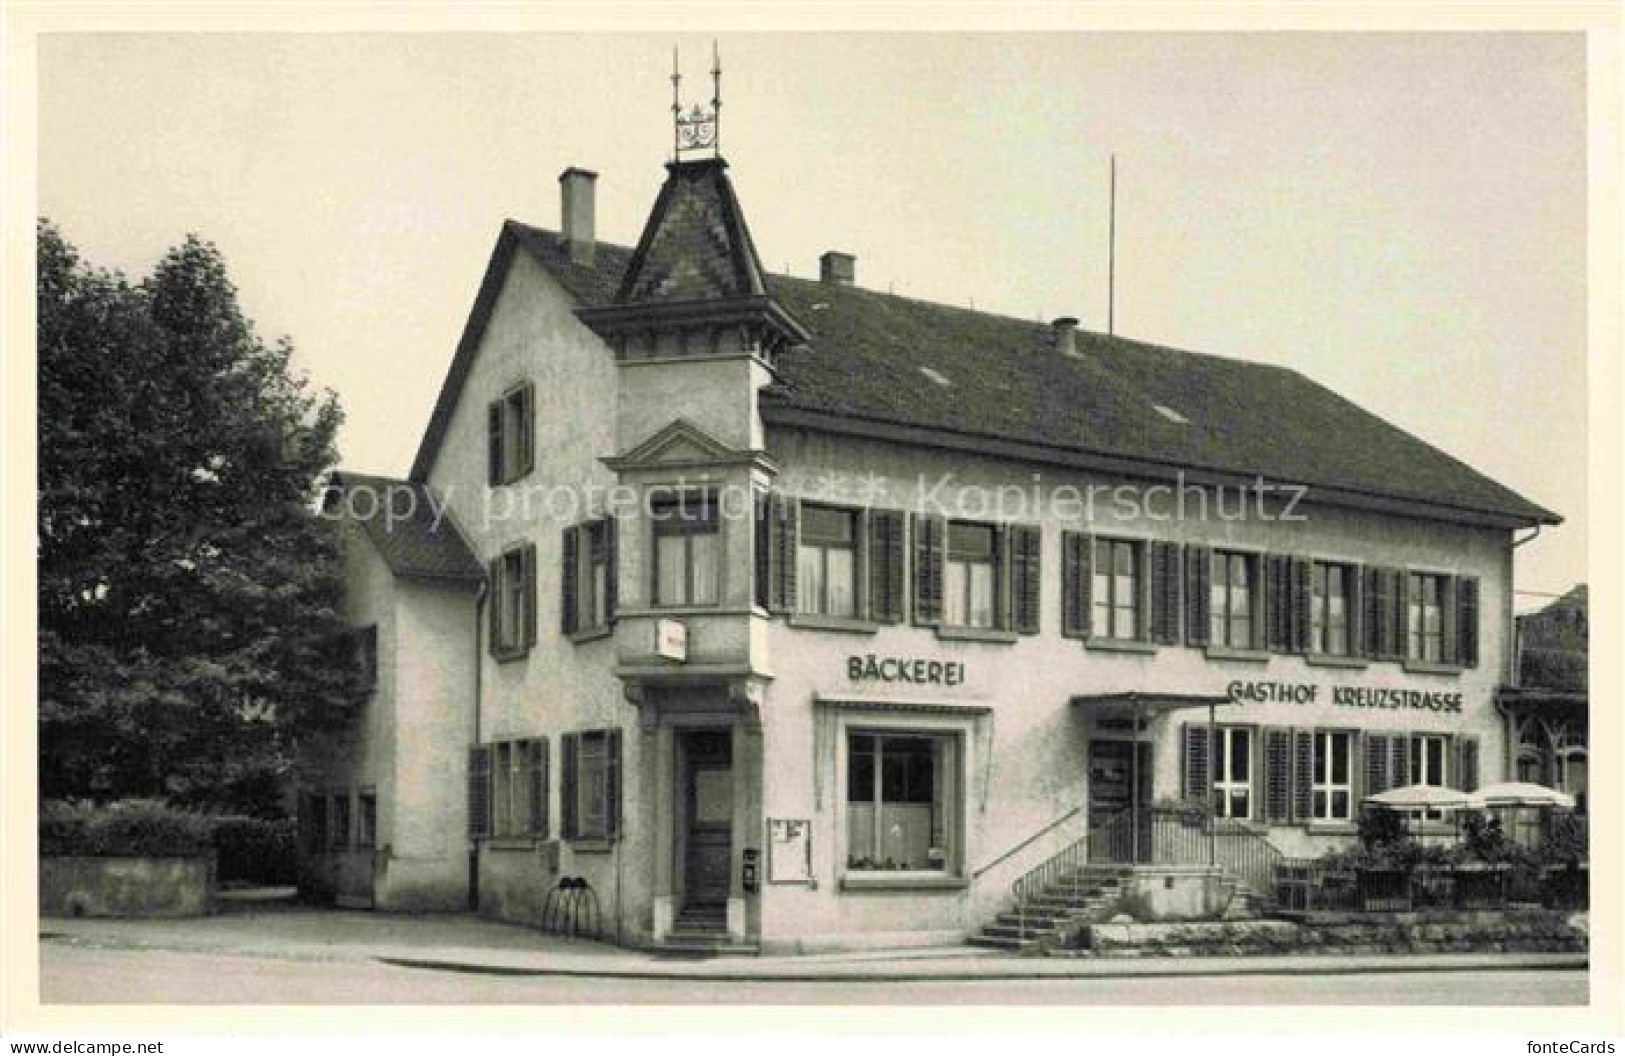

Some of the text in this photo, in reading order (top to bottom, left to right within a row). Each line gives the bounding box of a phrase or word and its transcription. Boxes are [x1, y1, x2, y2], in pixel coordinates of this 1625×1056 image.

[847, 654, 965, 686] BÄCKEREI
[1226, 680, 1463, 713] GASTHOF KREUZSTRASSE
